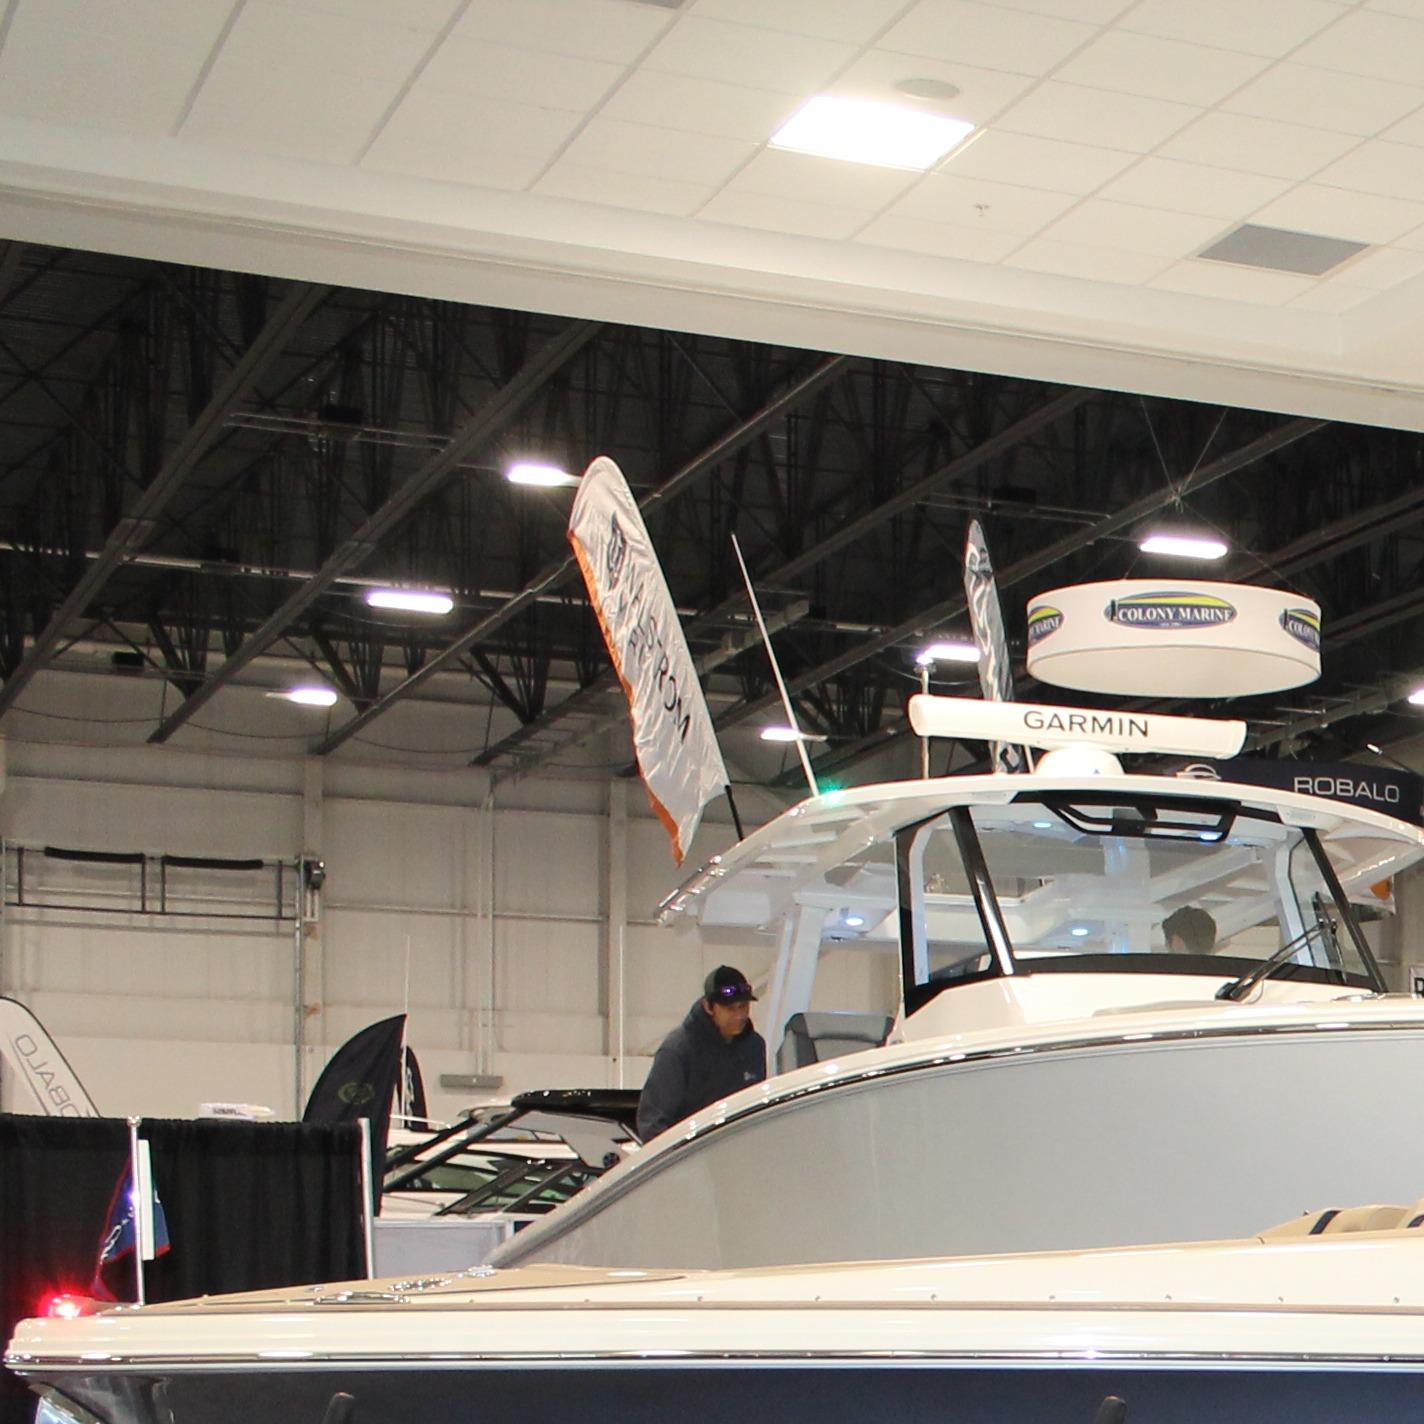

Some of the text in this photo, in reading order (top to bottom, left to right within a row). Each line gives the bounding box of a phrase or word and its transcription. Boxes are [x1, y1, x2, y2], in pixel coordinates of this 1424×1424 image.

[1118, 607, 1232, 622] COLONY MARINE
[1022, 709, 1149, 738] GARMIN
[1293, 776, 1401, 803] ROBALO
